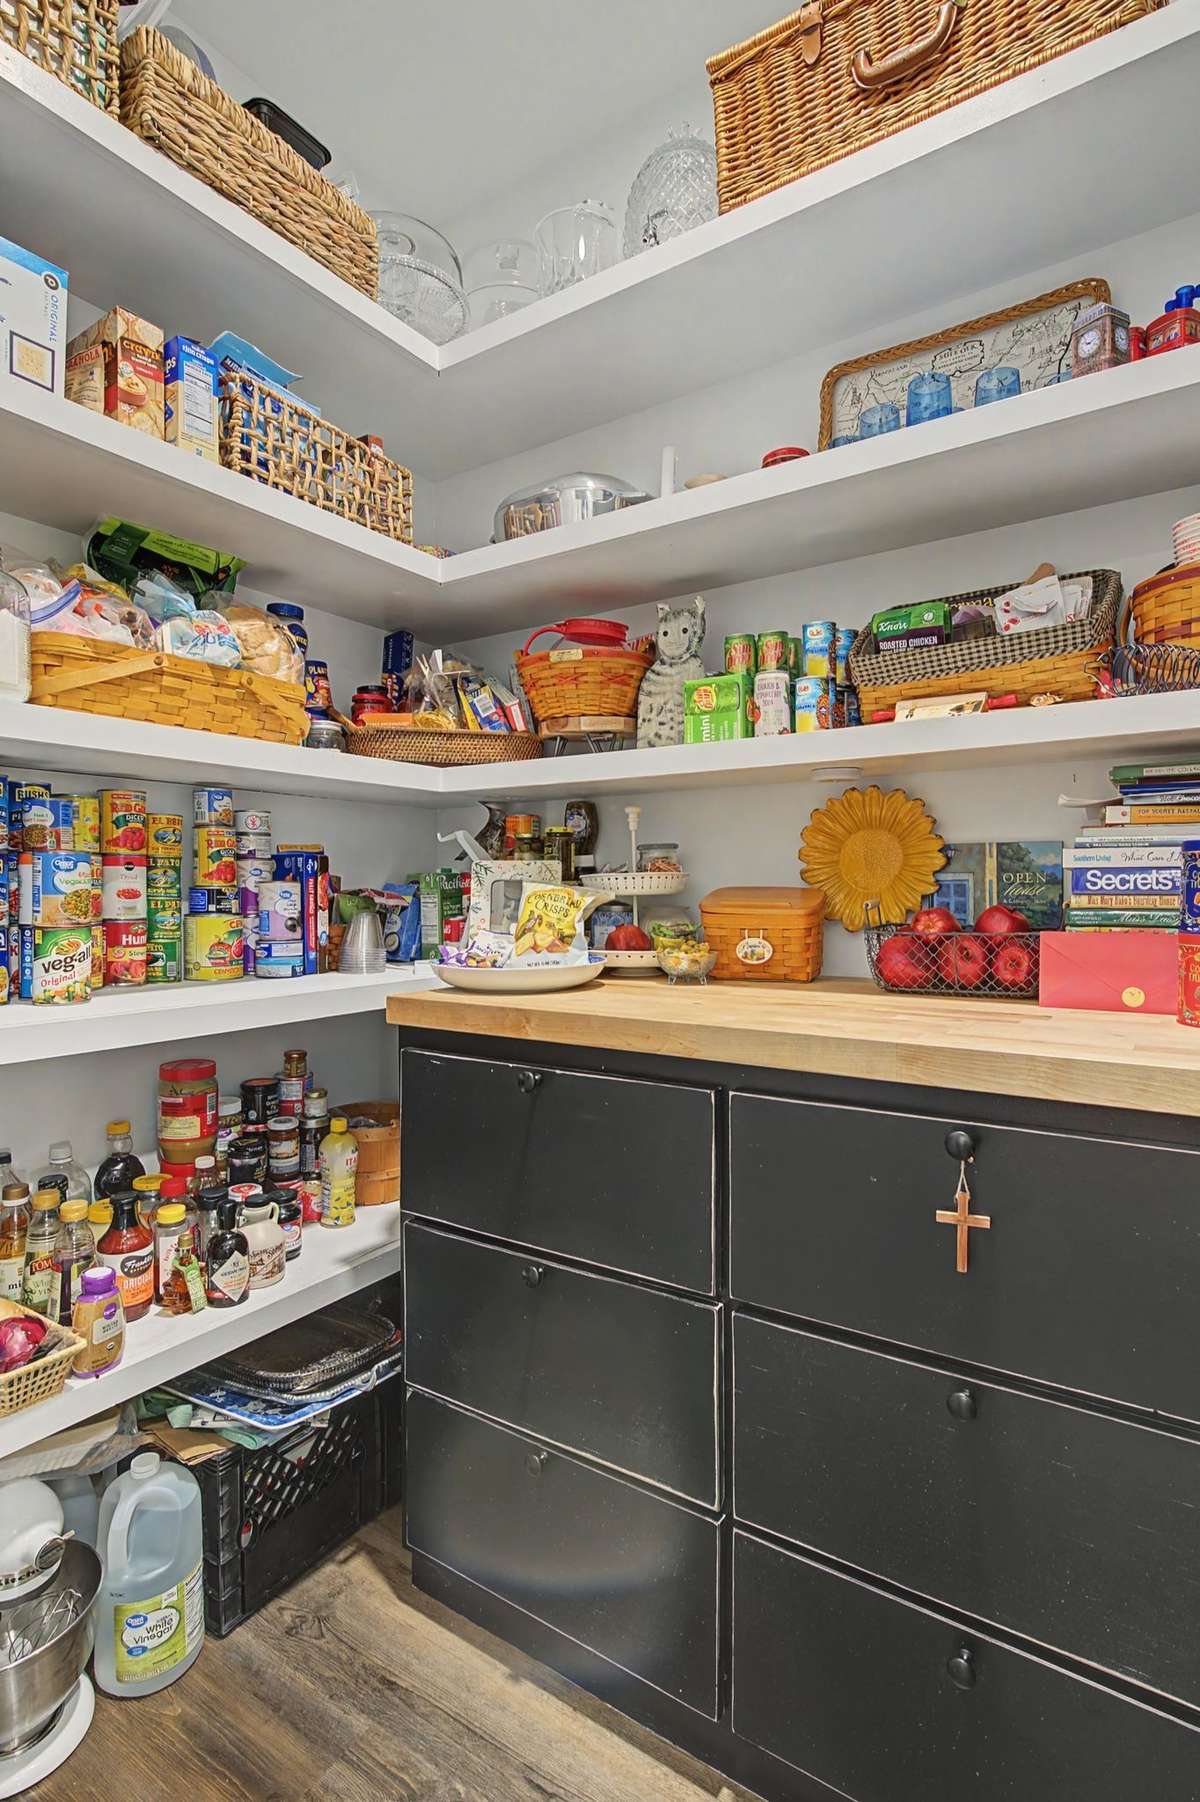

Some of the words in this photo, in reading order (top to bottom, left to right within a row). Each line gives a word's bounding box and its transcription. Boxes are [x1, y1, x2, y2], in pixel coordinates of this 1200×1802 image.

[50, 294, 59, 343] ORIGINAL
[878, 621, 909, 632] Knorr
[880, 639, 907, 650] ROASTED
[908, 635, 938, 646] CHICKEN
[308, 666, 328, 676] PLANT
[702, 714, 711, 743] mini
[1002, 872, 1047, 884] OPEN
[1085, 869, 1173, 891] Secrets
[1003, 881, 1046, 897] house
[534, 900, 570, 918] CRISPS
[121, 934, 147, 947] Hun
[40, 970, 76, 988] Original
[344, 1155, 358, 1167] ITA
[8, 1279, 21, 1291] mi
[145, 1616, 174, 1634] White
[133, 1623, 174, 1644] Vinegar
